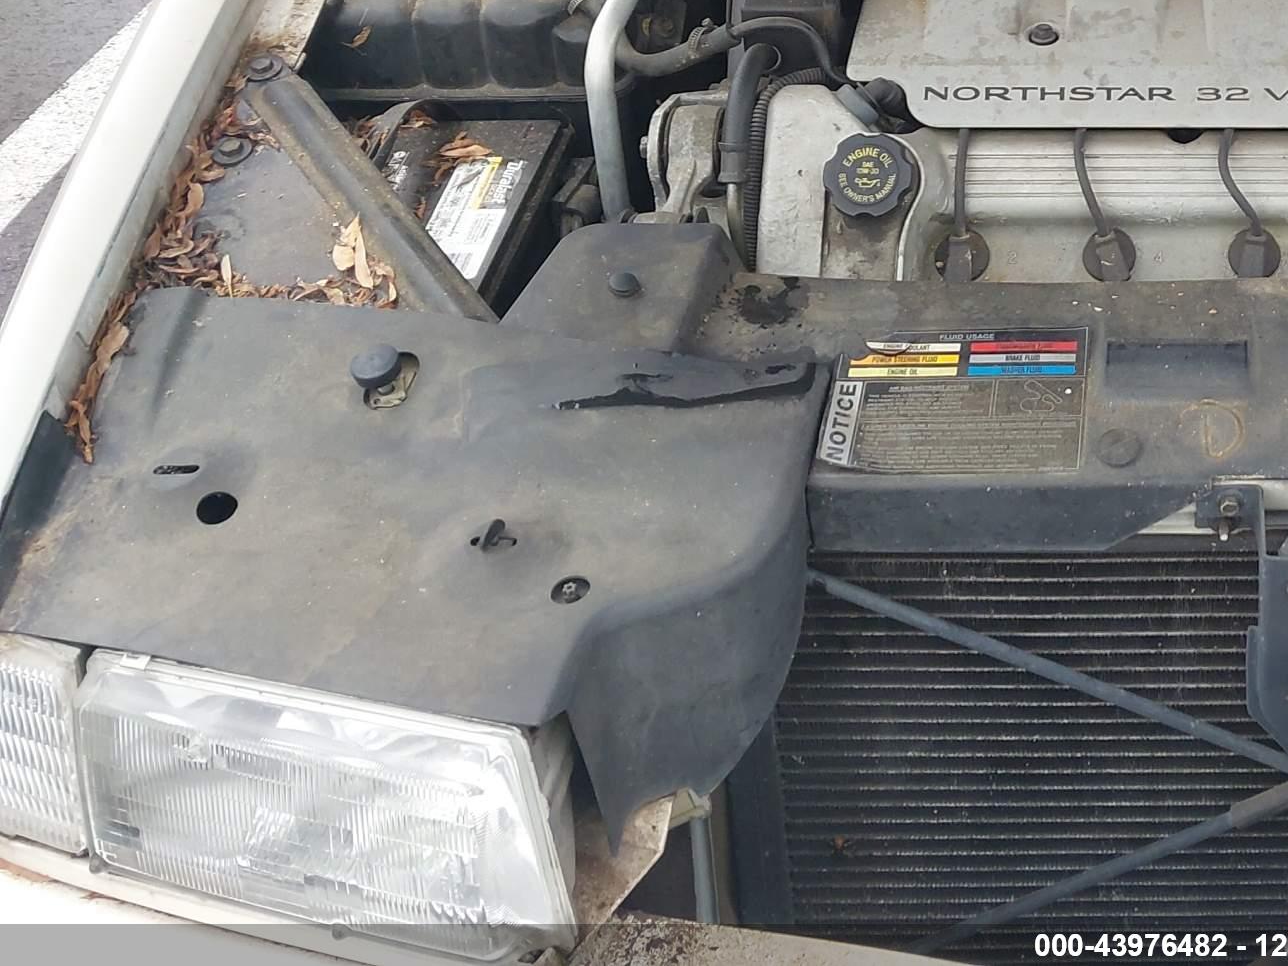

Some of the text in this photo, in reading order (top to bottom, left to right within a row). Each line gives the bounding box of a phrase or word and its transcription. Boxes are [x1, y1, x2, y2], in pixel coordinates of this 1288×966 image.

[924, 86, 1176, 102] NORTHSTAR
[1196, 86, 1250, 102] 32
[843, 147, 894, 168] ENGINE OIL
[491, 160, 524, 204] Duralast
[843, 187, 875, 202] OWNER'S
[875, 173, 897, 200] MANUAL
[826, 384, 857, 461] NOTICE
